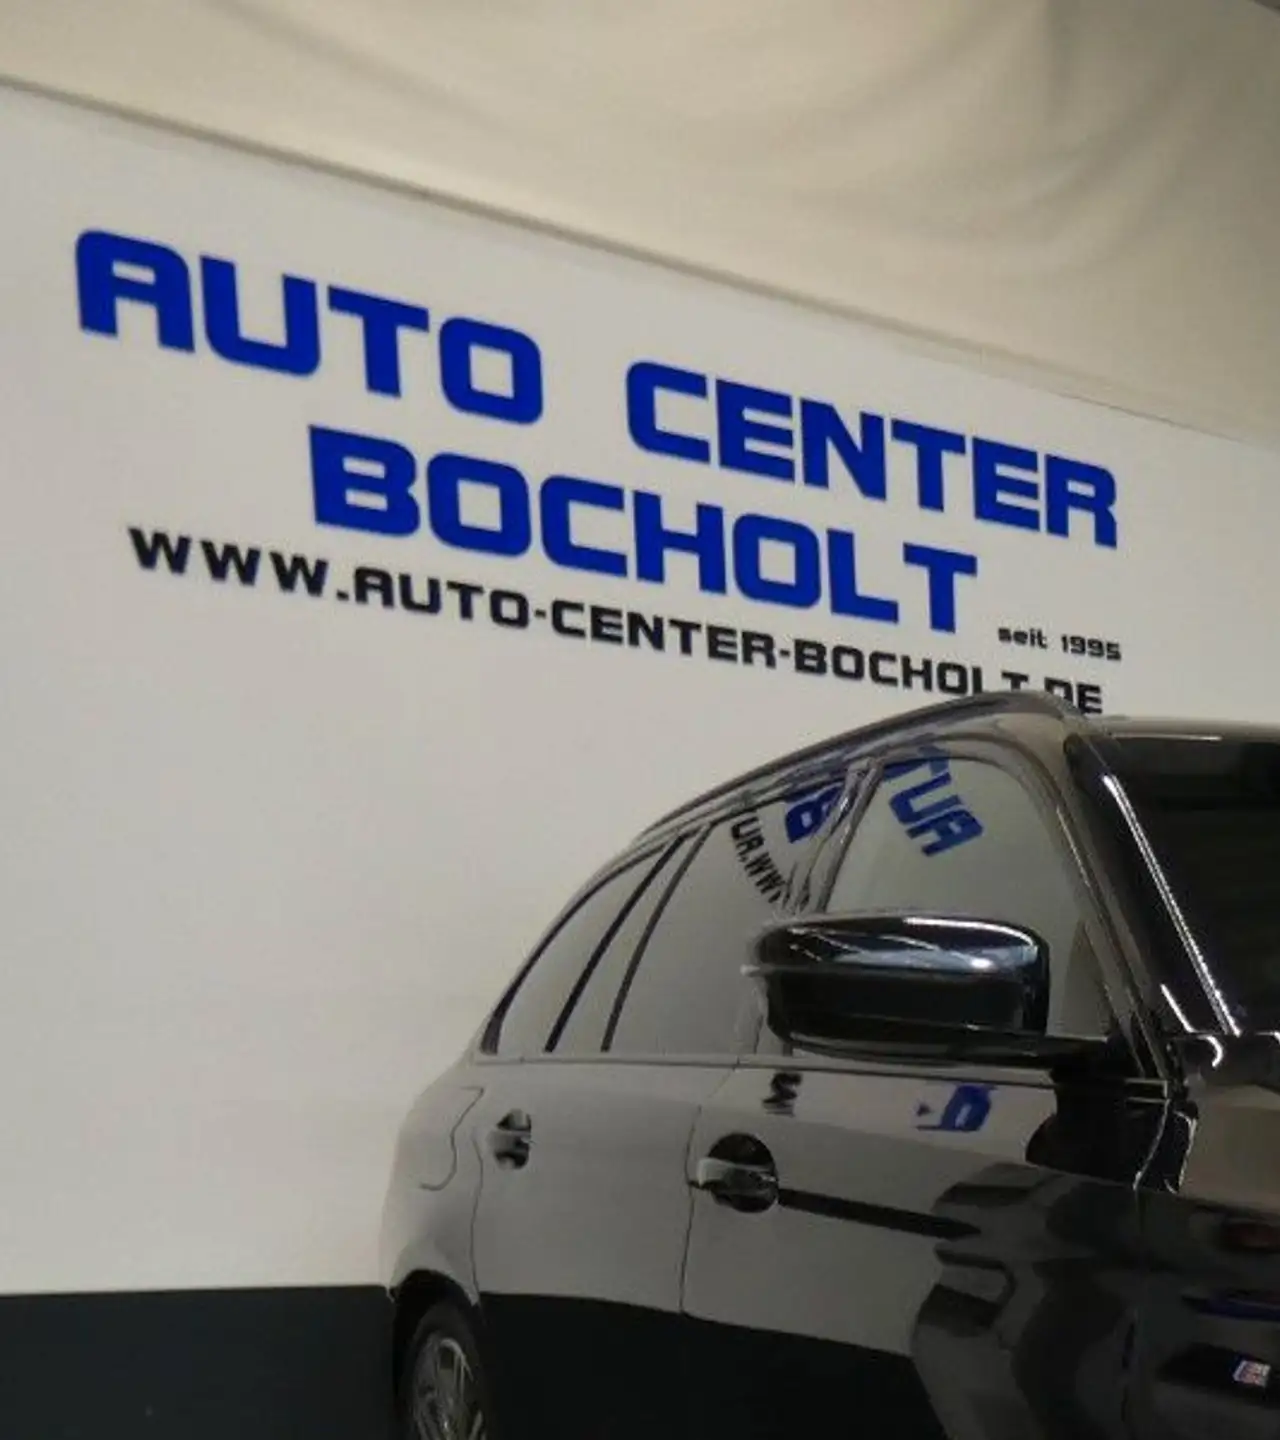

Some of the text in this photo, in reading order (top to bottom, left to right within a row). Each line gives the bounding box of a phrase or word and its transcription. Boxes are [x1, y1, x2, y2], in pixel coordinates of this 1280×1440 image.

[76, 230, 1117, 548] AUTO CENTER
[127, 527, 1103, 715] WWW.AUTO-CENTER-BOCHOLTDE
[309, 426, 977, 632] BOCHOLT
[998, 627, 1122, 661] seit 1995
